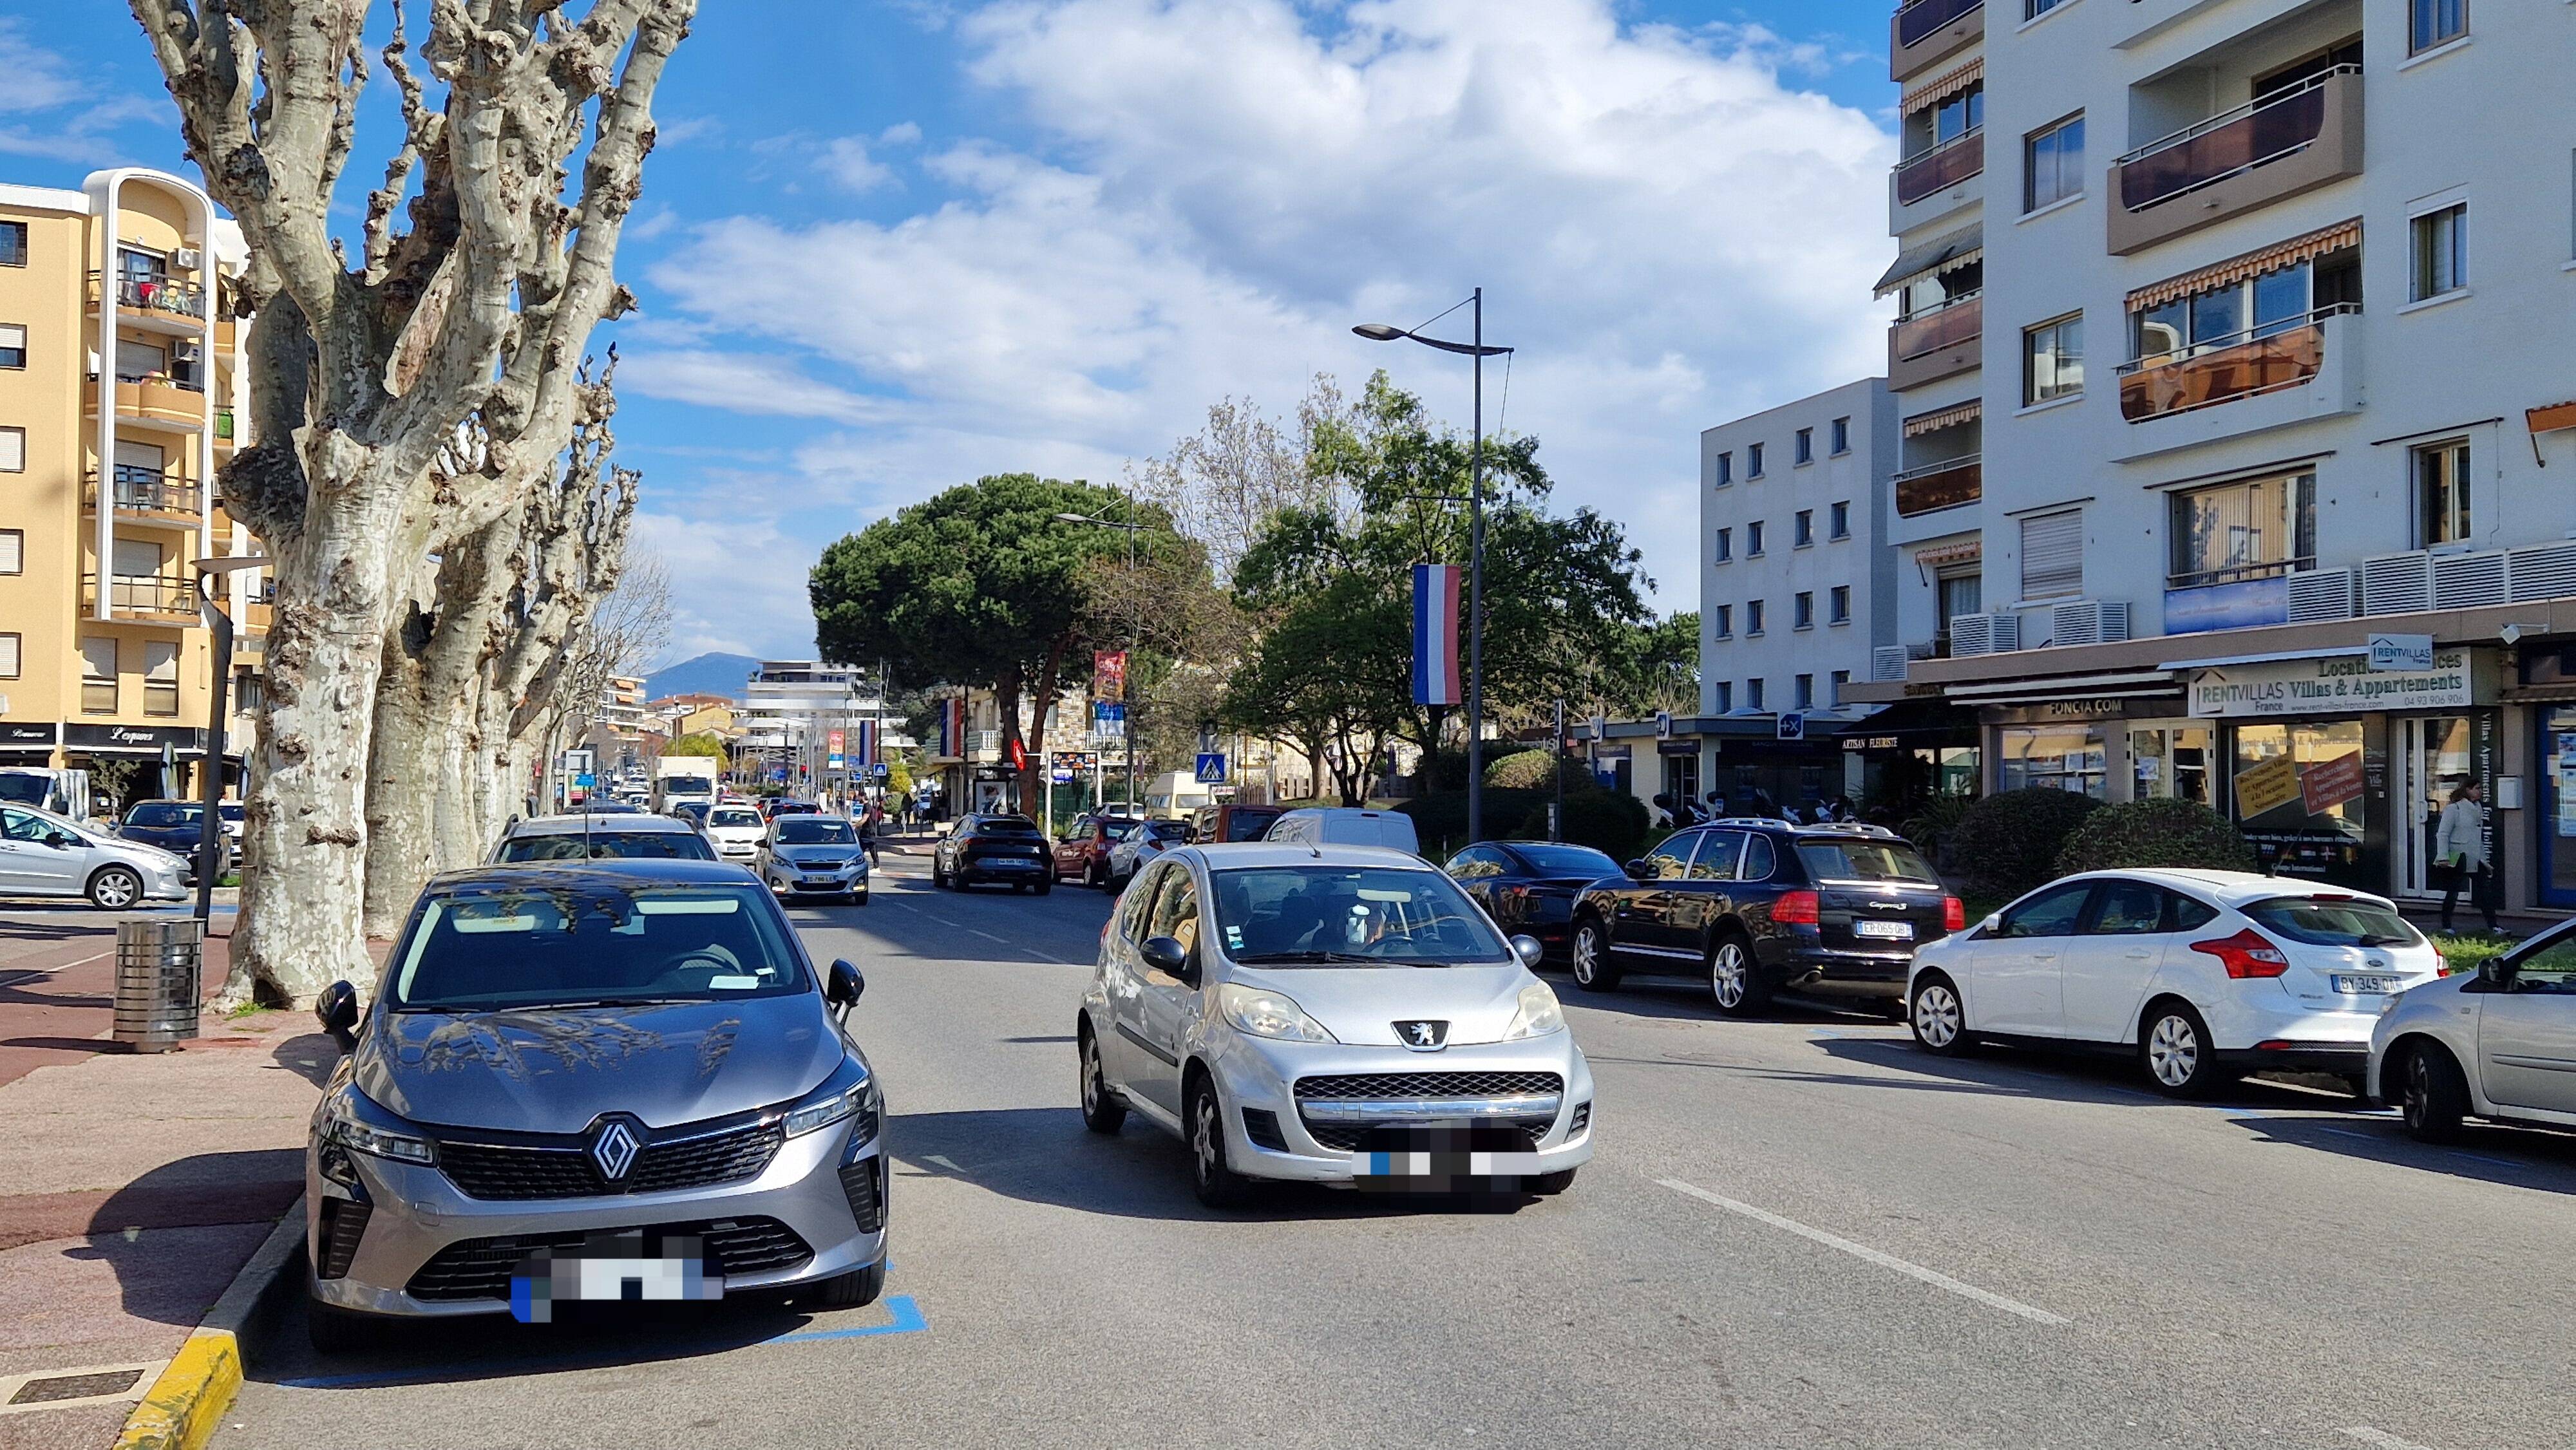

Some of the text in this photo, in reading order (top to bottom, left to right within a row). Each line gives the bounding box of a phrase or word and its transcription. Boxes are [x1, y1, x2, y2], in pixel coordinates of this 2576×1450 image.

[2378, 647, 2430, 658] RENTVILLAS
[2202, 682, 2284, 703] RENTVILLAS
[2289, 673, 2463, 699] Villas & Appartements
[2050, 699, 2122, 714] FONCIA COM
[2255, 701, 2283, 712] France
[2291, 699, 2384, 712] www.rent-villas-france.com
[2405, 693, 2464, 706] 04 93 906 906
[2481, 712, 2492, 740] Villas
[1842, 737, 1898, 749] ARTISAN FLEURISTE
[2479, 745, 2492, 803] Apartments
[2482, 807, 2494, 824] for
